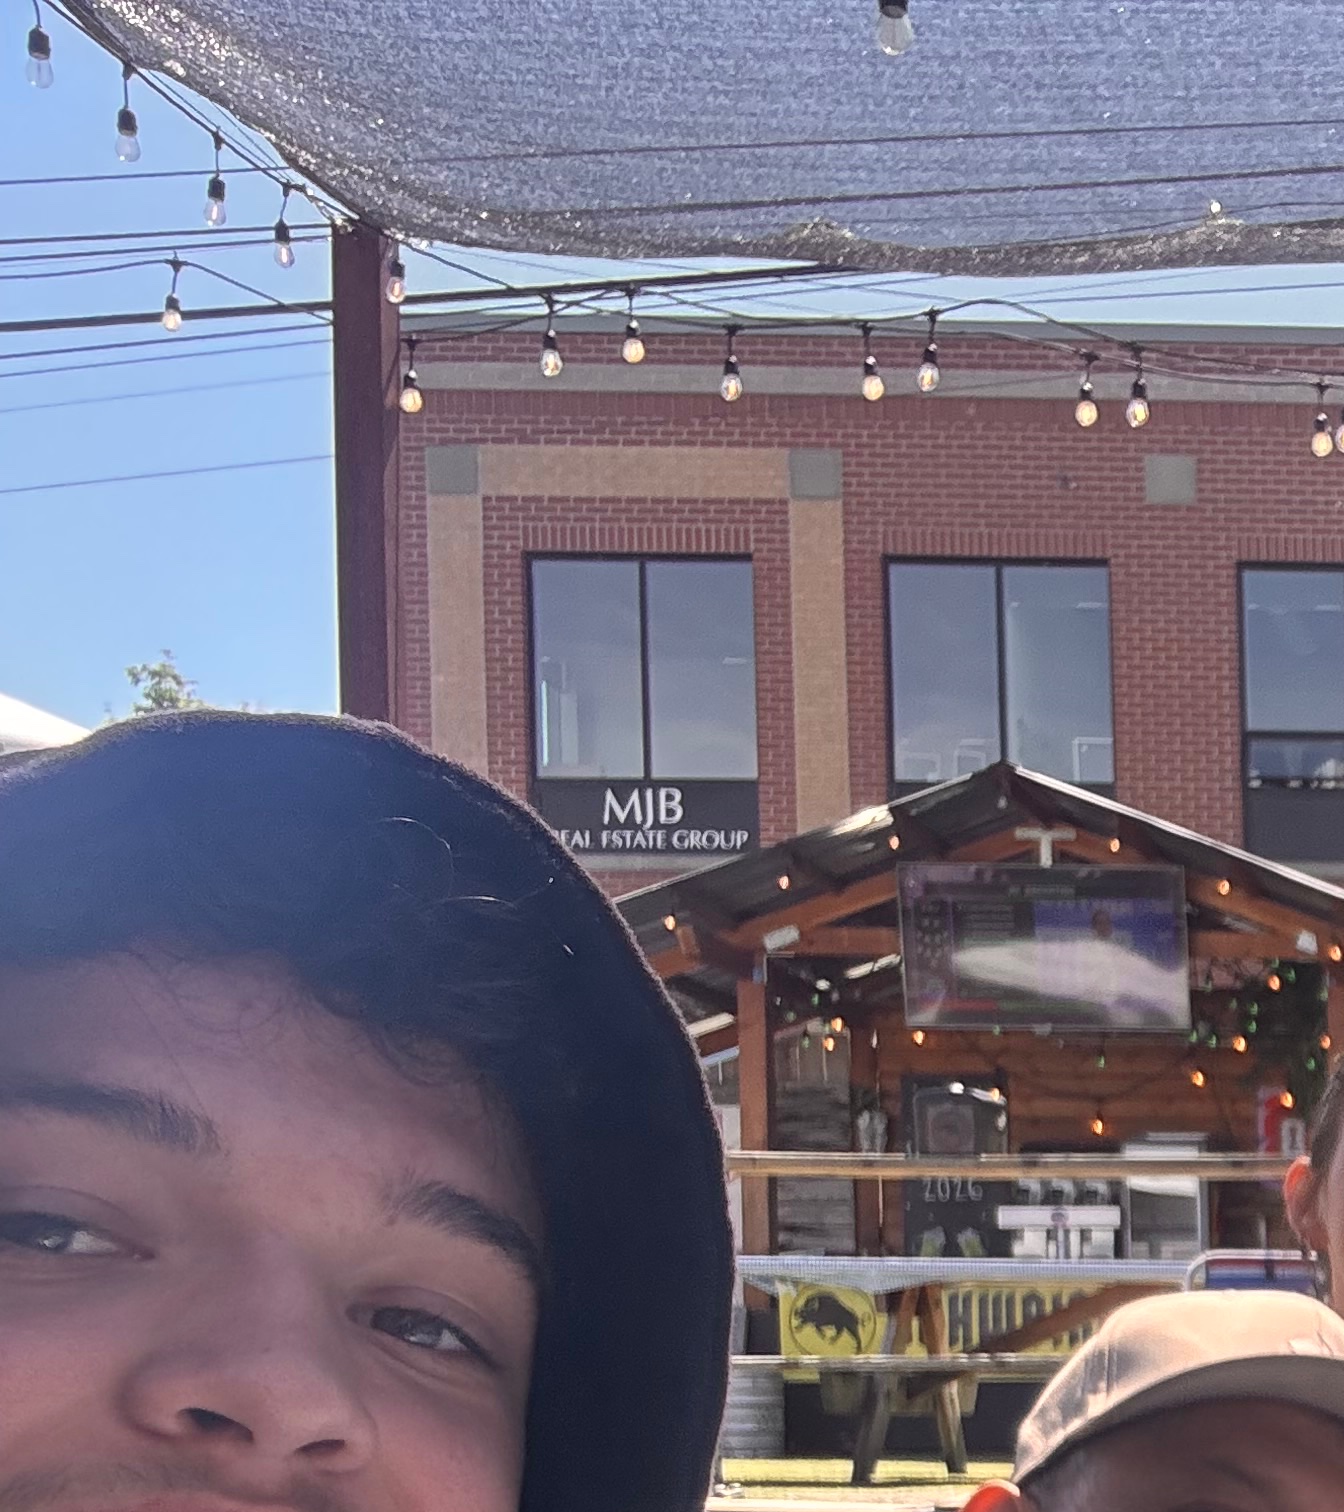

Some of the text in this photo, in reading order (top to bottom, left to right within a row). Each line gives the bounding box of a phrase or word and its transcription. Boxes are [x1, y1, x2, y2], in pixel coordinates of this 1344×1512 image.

[603, 787, 684, 830] MJB
[601, 829, 667, 850] ESTATE
[672, 829, 749, 851] GROUP
[922, 1176, 983, 1202] 2026
